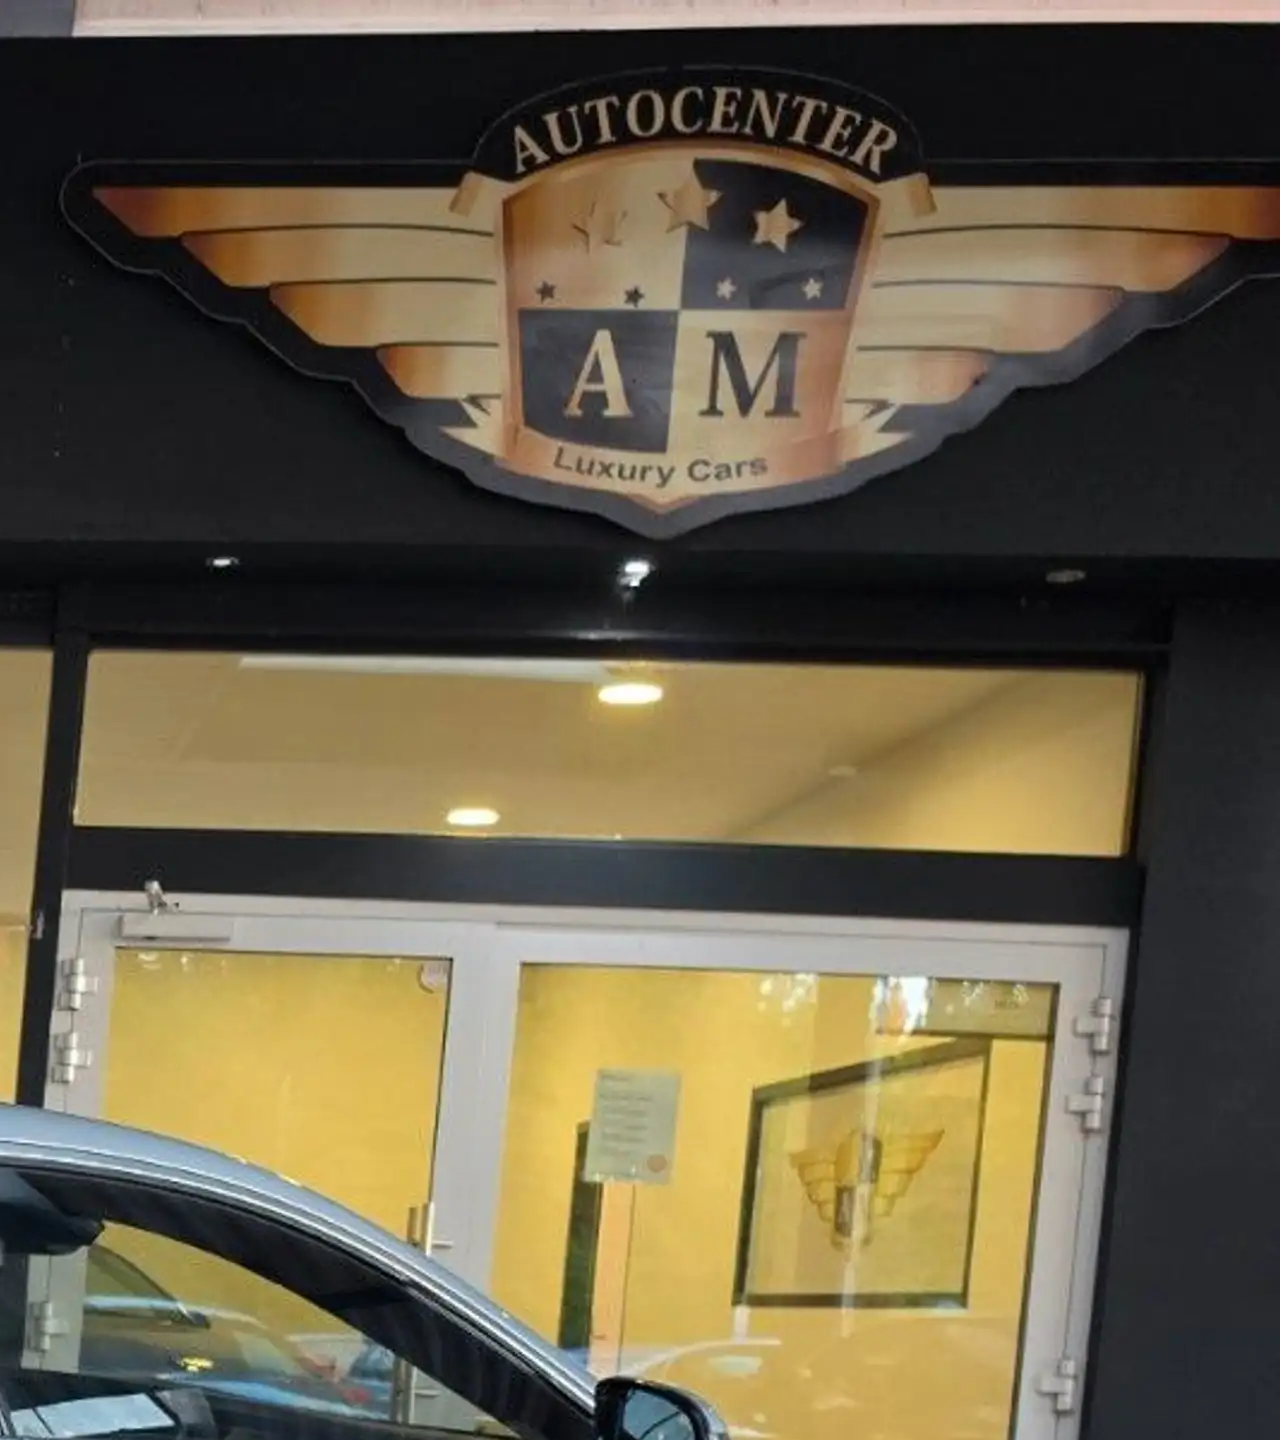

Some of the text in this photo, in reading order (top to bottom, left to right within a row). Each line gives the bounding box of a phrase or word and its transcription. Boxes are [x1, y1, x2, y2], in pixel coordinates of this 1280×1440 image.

[513, 85, 899, 175] AUTOCENTER
[563, 328, 808, 418] A M
[552, 446, 768, 488] Luxury Cars
